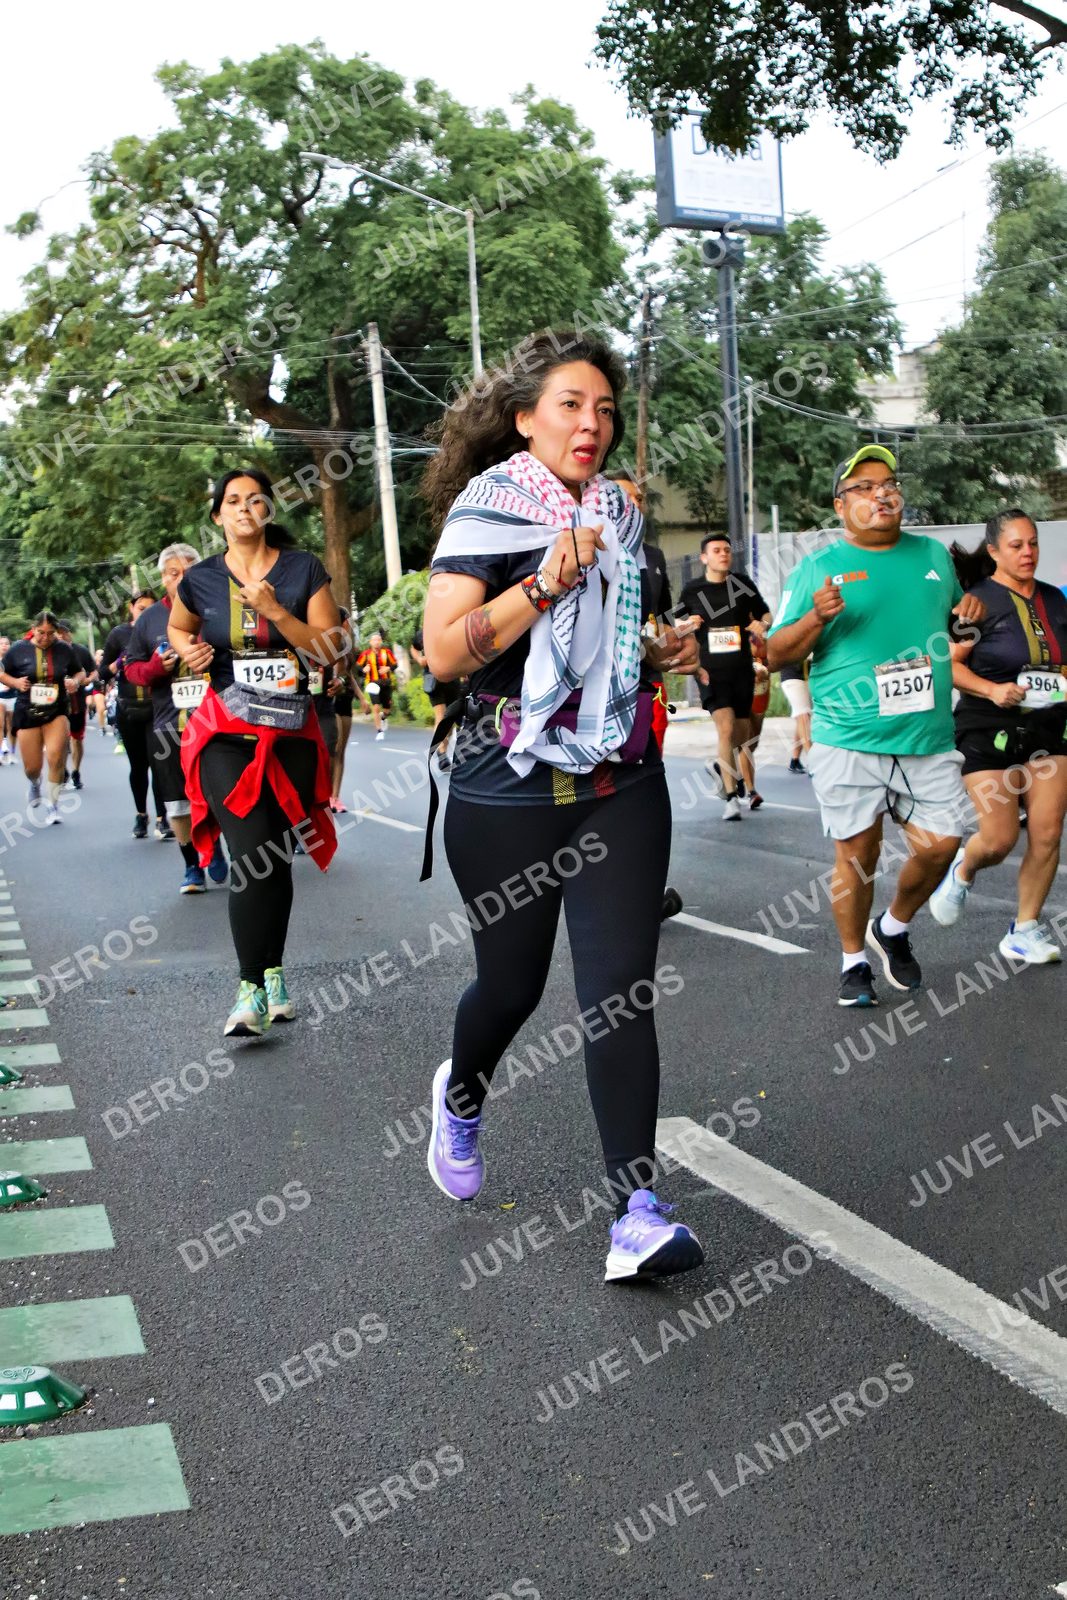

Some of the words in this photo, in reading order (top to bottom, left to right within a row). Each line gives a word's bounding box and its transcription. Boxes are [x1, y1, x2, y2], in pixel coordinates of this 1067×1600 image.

[242, 664, 287, 683] 1945
[177, 684, 203, 697] 4177
[881, 674, 933, 698] 12507
[1026, 676, 1060, 692] 3964
